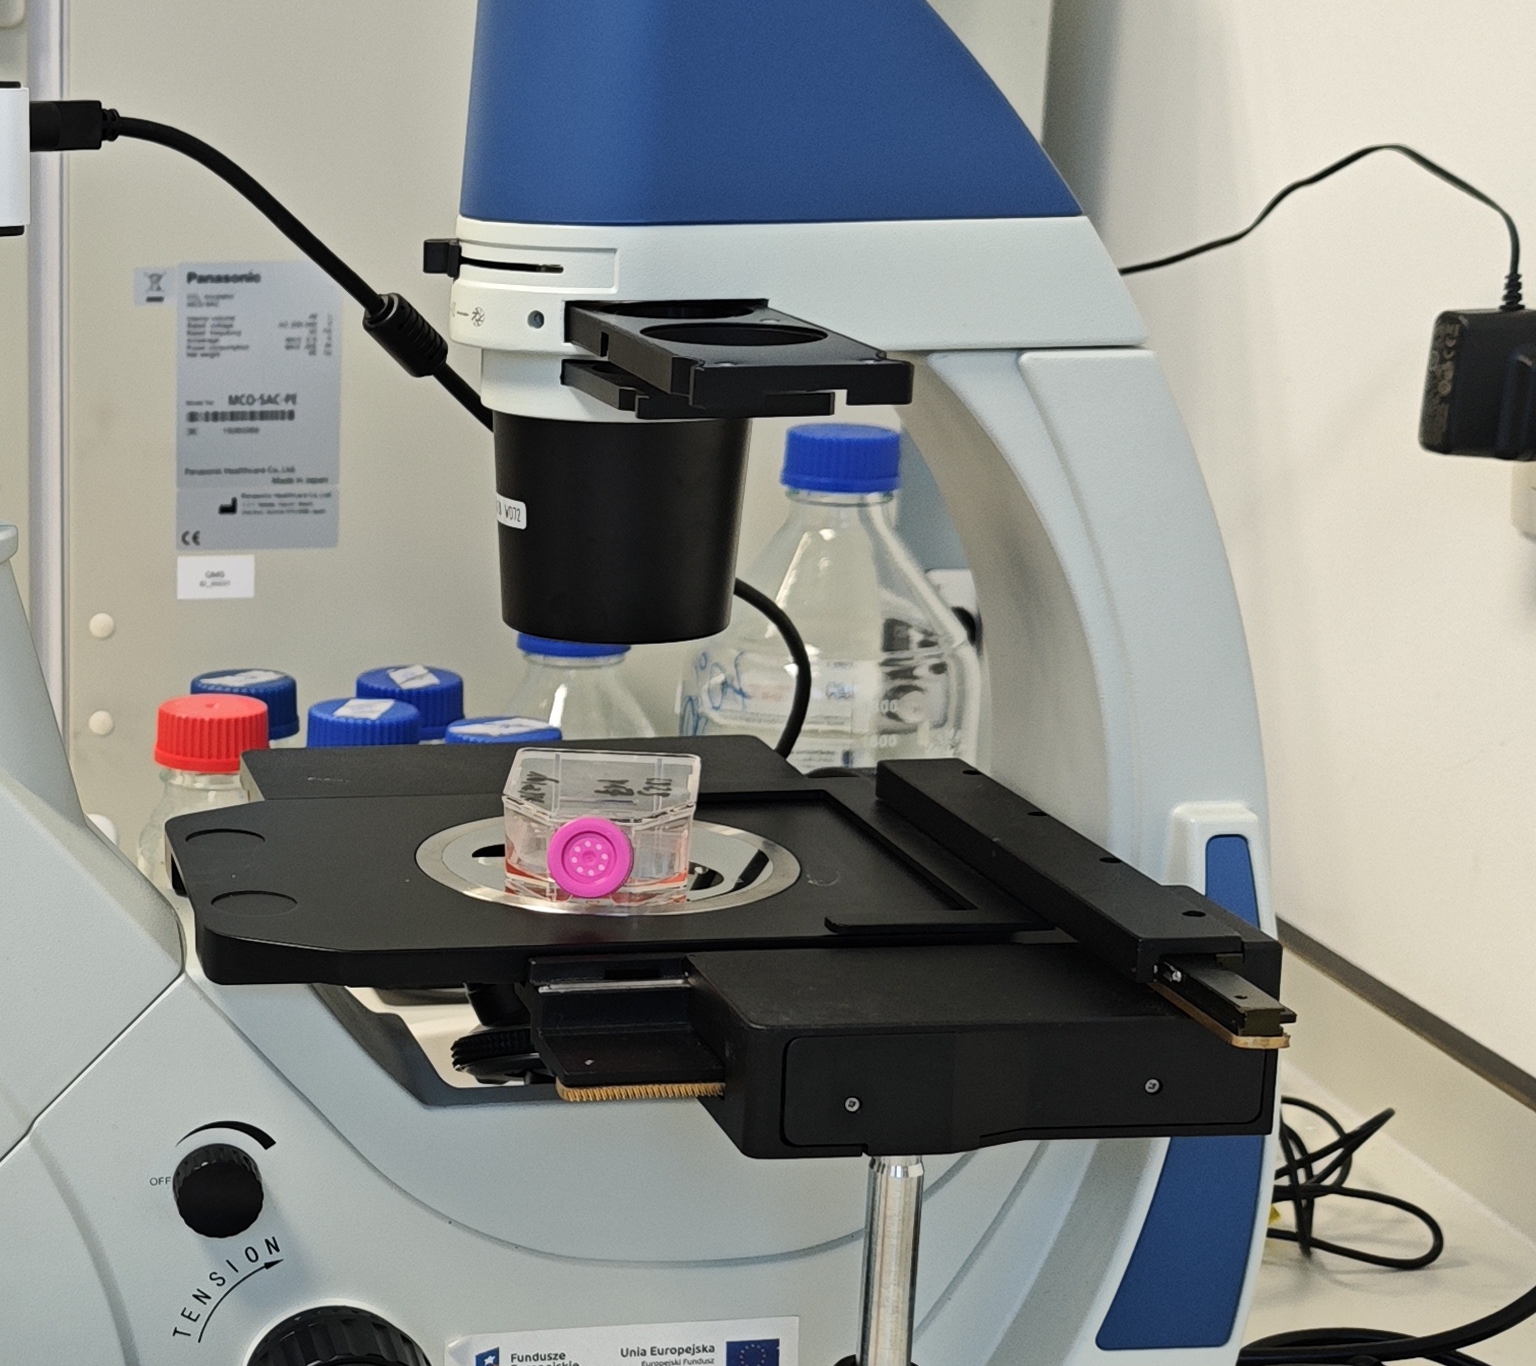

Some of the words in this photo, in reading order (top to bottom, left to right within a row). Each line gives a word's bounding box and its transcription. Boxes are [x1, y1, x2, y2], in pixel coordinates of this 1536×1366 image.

[186, 270, 261, 284] Panasonic
[149, 1176, 172, 1186] OFF
[172, 1236, 281, 1337] TENSION
[620, 1346, 647, 1358] Unia
[650, 1343, 715, 1357] Europejska
[510, 1352, 566, 1363] Fundusze
[683, 1358, 715, 1366] Fundusz
